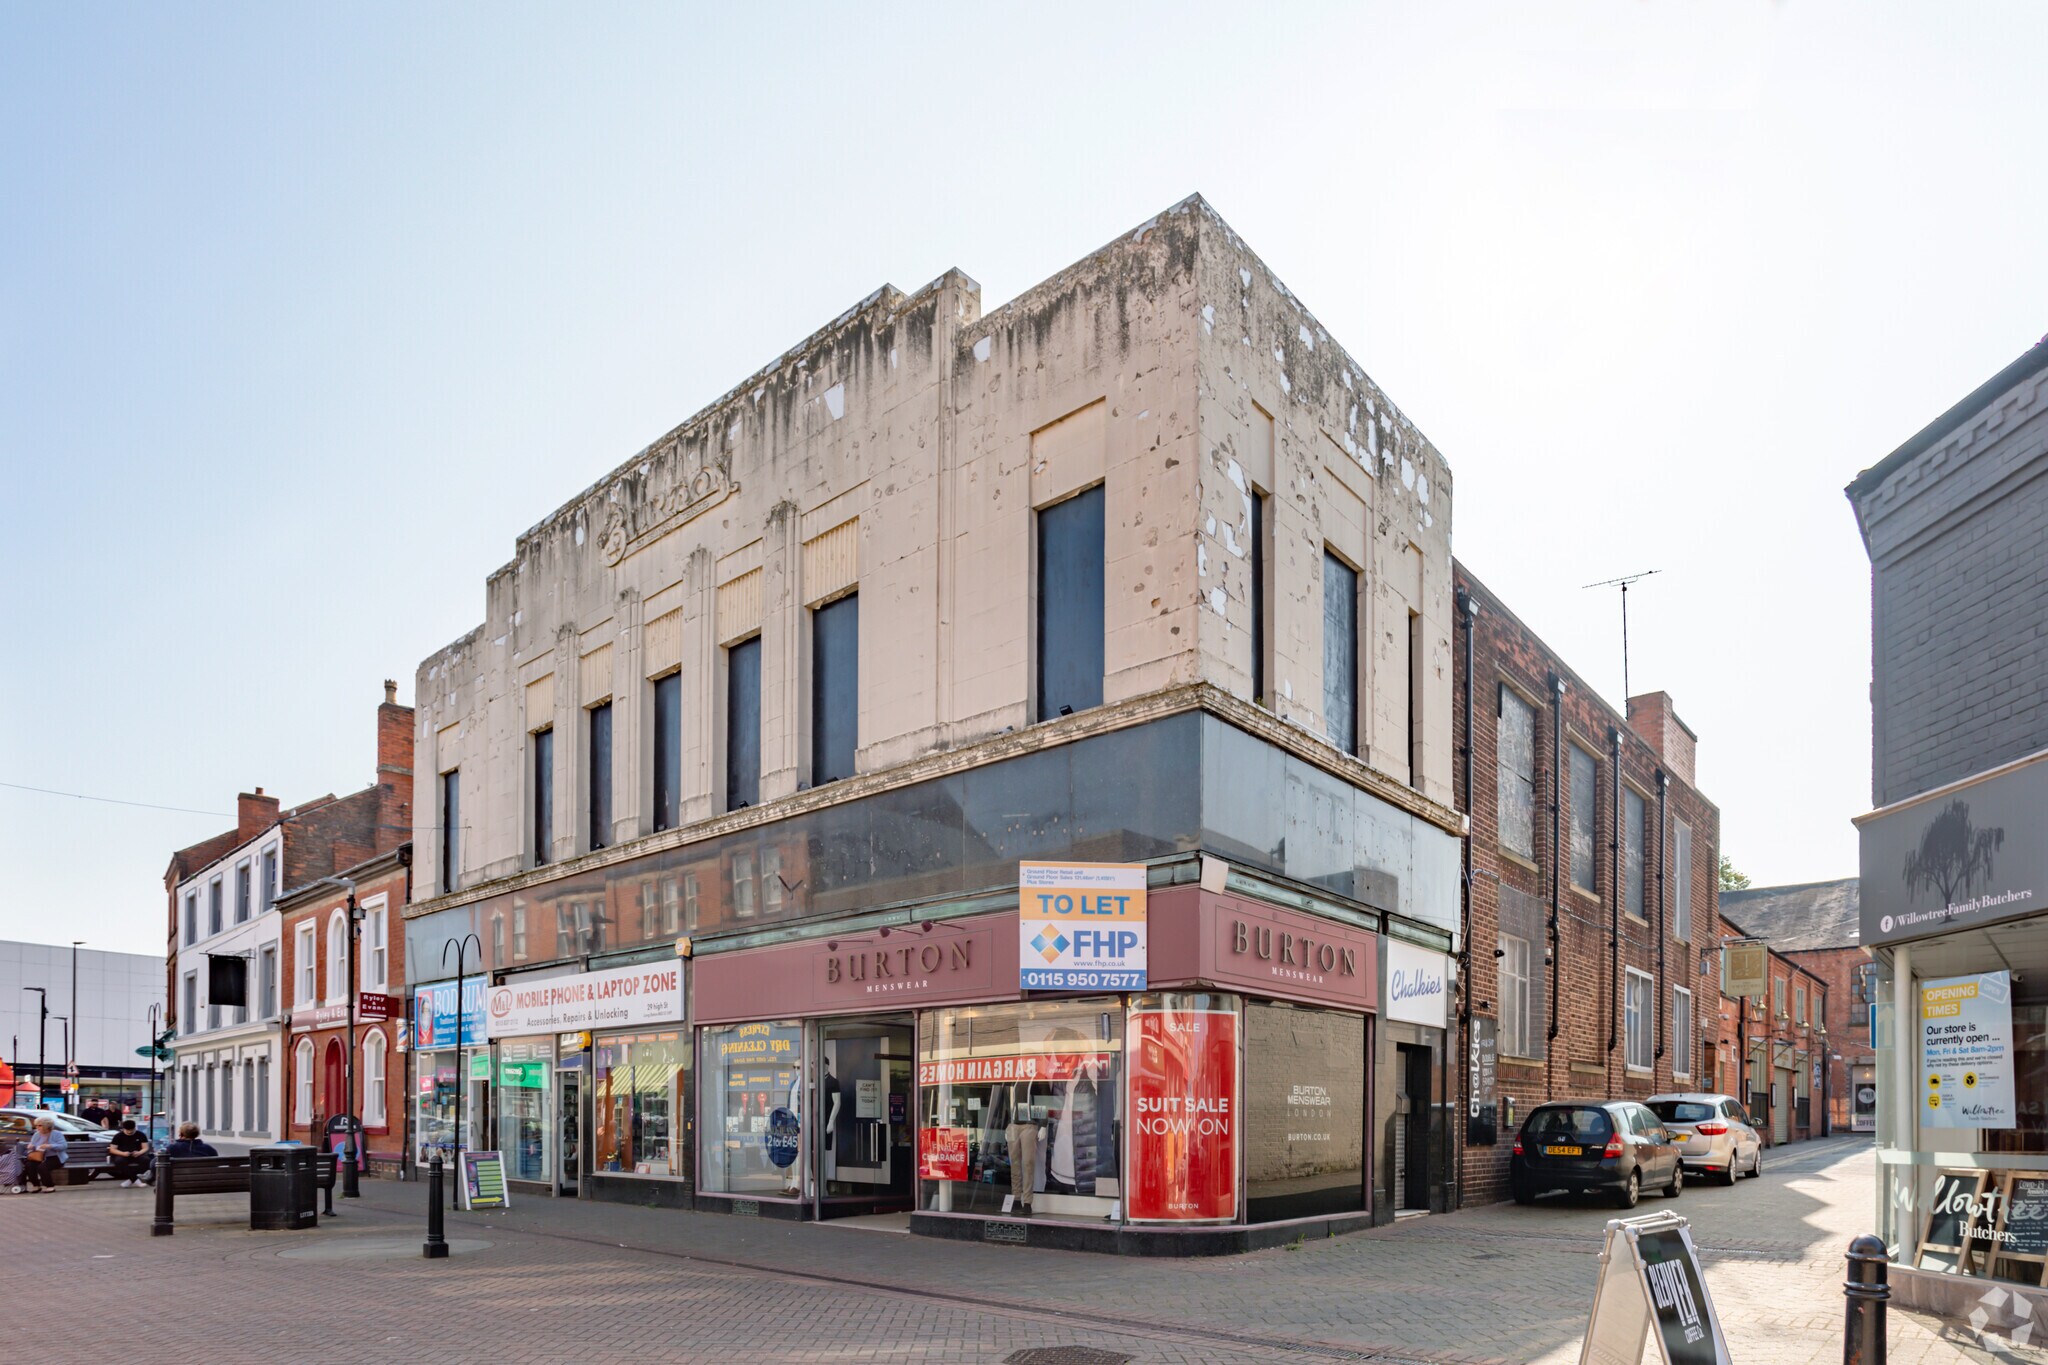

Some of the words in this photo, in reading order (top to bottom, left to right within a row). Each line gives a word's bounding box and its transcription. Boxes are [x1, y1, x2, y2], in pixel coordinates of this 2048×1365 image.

[1037, 894, 1073, 914] TO
[1081, 895, 1130, 915] LET
[1073, 930, 1138, 958] FHP
[1233, 920, 1356, 978] BURTON
[827, 939, 972, 984] BURTON
[1027, 973, 1064, 985] 0115
[1067, 973, 1101, 986] 950
[1101, 973, 1139, 986] 7577
[1271, 966, 1324, 984] MENSWEAR
[516, 989, 549, 1010] MOBILE
[551, 984, 585, 1006] PHONE
[587, 984, 594, 1000] &
[597, 976, 640, 999] LAPTOP
[643, 971, 677, 994] ZONE
[866, 980, 928, 993] MENSWEAR
[1391, 968, 1442, 1001] Chalkies
[363, 994, 385, 1003] Ryley
[1926, 985, 1976, 1001] OPENING
[434, 983, 487, 1018] BODRUM
[563, 1010, 586, 1024] Repairs
[587, 1010, 593, 1020] &
[595, 1008, 628, 1020] Unlocking
[1926, 1003, 1959, 1017] TIMES
[1169, 1023, 1200, 1032] SALE
[1926, 1025, 1942, 1035] Our
[1944, 1024, 1967, 1034] store
[1968, 1021, 1976, 1032] is
[1926, 1034, 1964, 1046] currently
[1965, 1034, 1990, 1045] open
[1942, 1047, 1951, 1055] Fri
[1958, 1046, 1969, 1054] Sat
[1293, 1085, 1327, 1096] BURTON
[1137, 1098, 1181, 1112] SUIT
[1185, 1098, 1228, 1112] SALE
[1287, 1095, 1331, 1106] MENSWEAR
[1287, 1108, 1332, 1118] LONDON
[1136, 1119, 1191, 1135] NOW
[1199, 1119, 1228, 1135] ON
[767, 1135, 773, 1147] 2
[782, 1135, 798, 1148] £45
[1288, 1133, 1331, 1141] BURTON.CO.UK
[1548, 1146, 1566, 1154] DE54
[1959, 1220, 2017, 1243] Butchers
